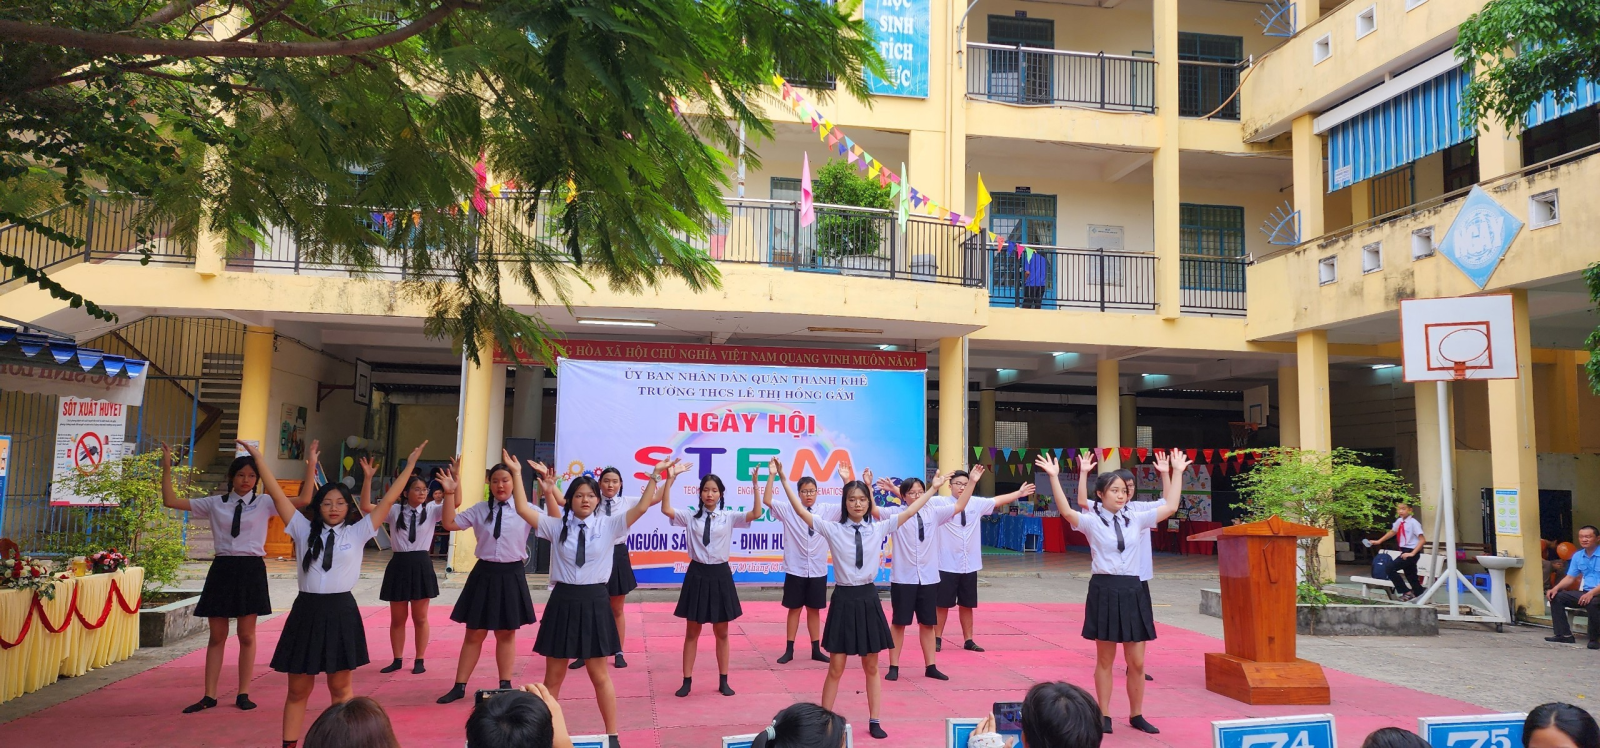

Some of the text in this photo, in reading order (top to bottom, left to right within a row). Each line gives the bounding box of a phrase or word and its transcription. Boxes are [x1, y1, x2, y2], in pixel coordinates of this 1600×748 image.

[880, 15, 914, 35] SINH
[880, 37, 914, 61] TÍCH
[882, 65, 912, 90] ỰC
[576, 344, 602, 357] HÒA
[605, 345, 622, 357] XÃ
[625, 345, 648, 360] HỘI
[651, 345, 676, 359] CHỦ
[679, 347, 717, 361] NGHĨA
[720, 348, 748, 363] VIỆT
[751, 351, 777, 362] NAM
[779, 352, 819, 364] QUANG
[823, 354, 850, 365] VINH
[852, 354, 886, 366] MUÔN
[888, 355, 917, 367] NĂM!
[624, 367, 868, 386] ỦY BAN NHÂN DÂN QUẬN THANH KHÊ
[637, 383, 695, 397] TRƯỜNG
[699, 388, 734, 398] THCS
[738, 386, 755, 398] LÊ
[759, 389, 781, 400] THỊ
[785, 386, 822, 400] HỒNG
[678, 409, 816, 438] NGÀY HỘI
[633, 446, 856, 482] STEM
[626, 527, 668, 551] NGUỒN
[740, 533, 768, 554] ĐỊNH
